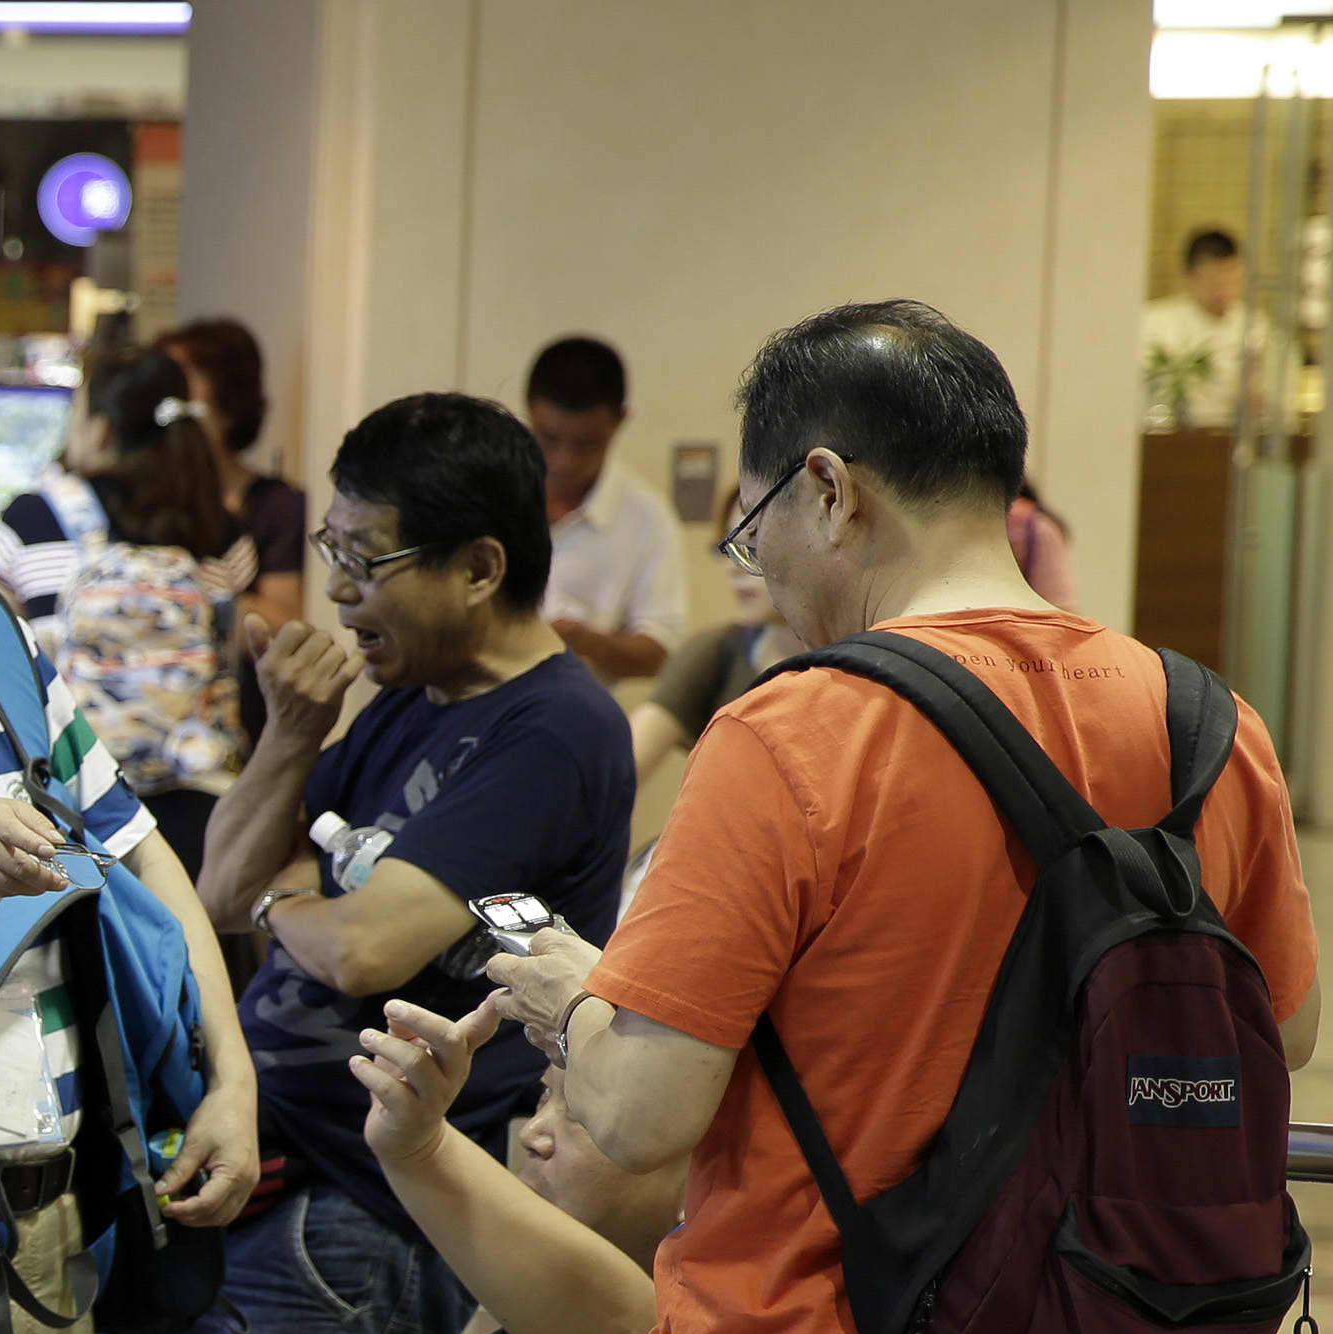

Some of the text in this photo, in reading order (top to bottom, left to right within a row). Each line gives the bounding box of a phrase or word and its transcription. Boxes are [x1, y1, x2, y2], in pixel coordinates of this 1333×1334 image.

[950, 652, 1126, 680] pen your heart
[1128, 1077, 1236, 1108] JANSPORT
